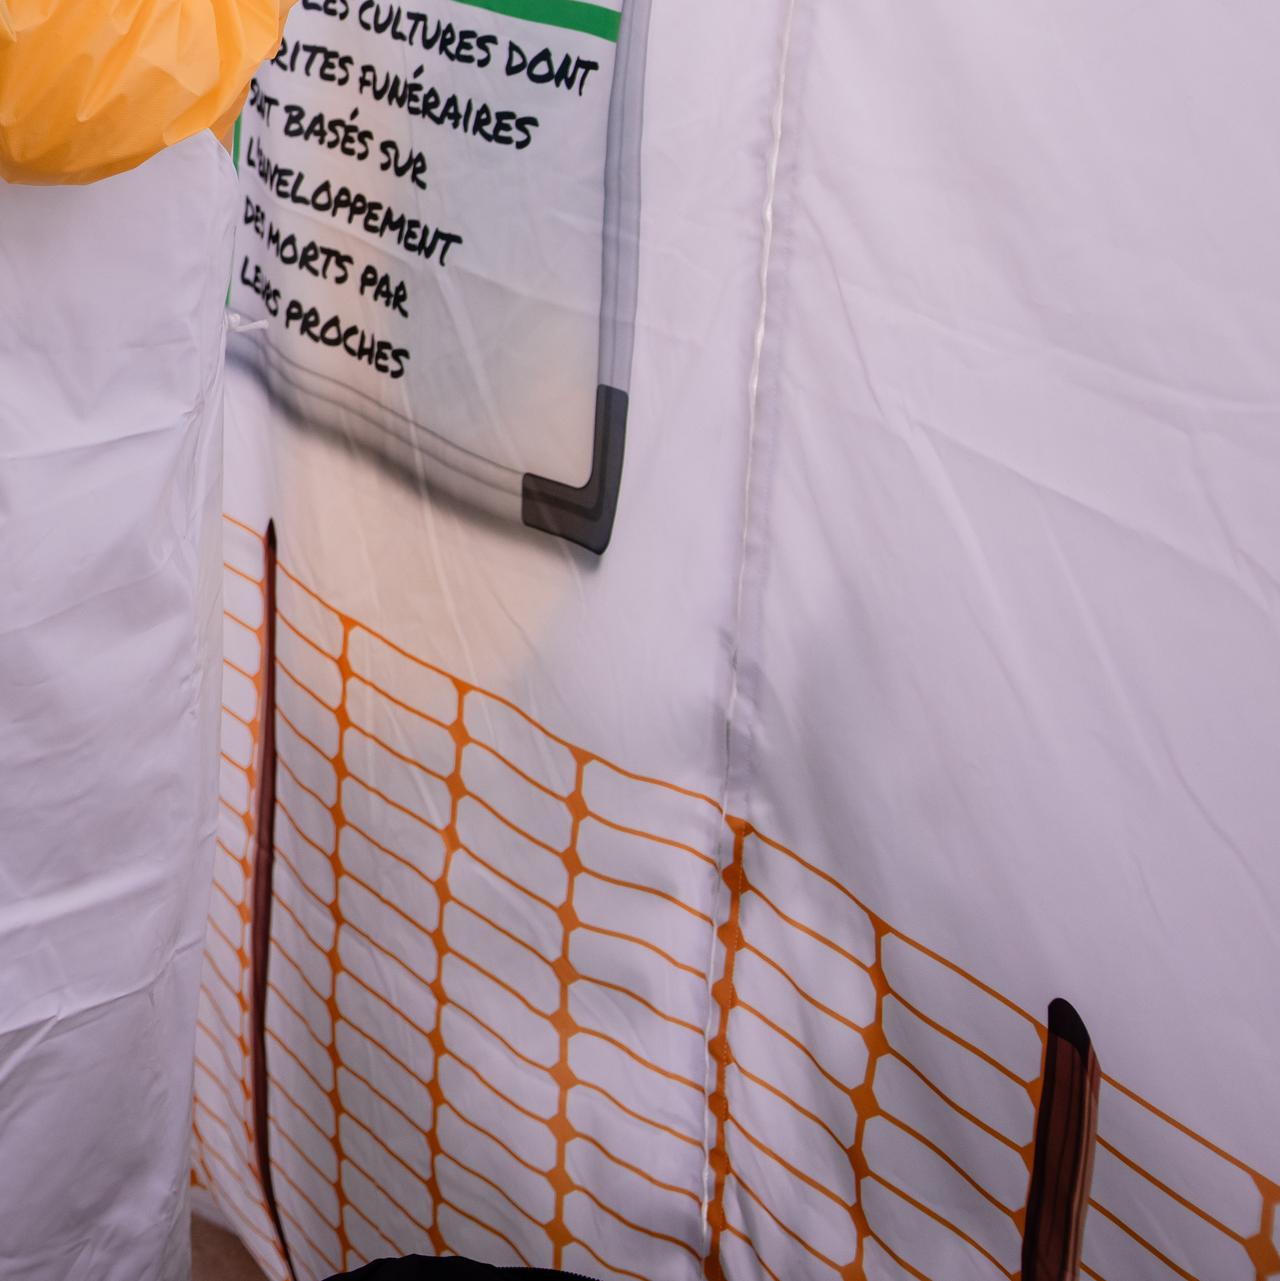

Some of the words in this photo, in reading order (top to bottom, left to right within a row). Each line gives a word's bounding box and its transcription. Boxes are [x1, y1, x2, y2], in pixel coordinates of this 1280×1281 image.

[270, 39, 354, 86] RITES
[359, 64, 539, 150] FUNÉRAIRES
[505, 40, 599, 96] DONT
[284, 105, 374, 161] BASÉS
[380, 140, 427, 190] SUR
[267, 222, 354, 284] MORTS
[360, 265, 408, 318] PAR
[285, 300, 410, 379] PROCHES
